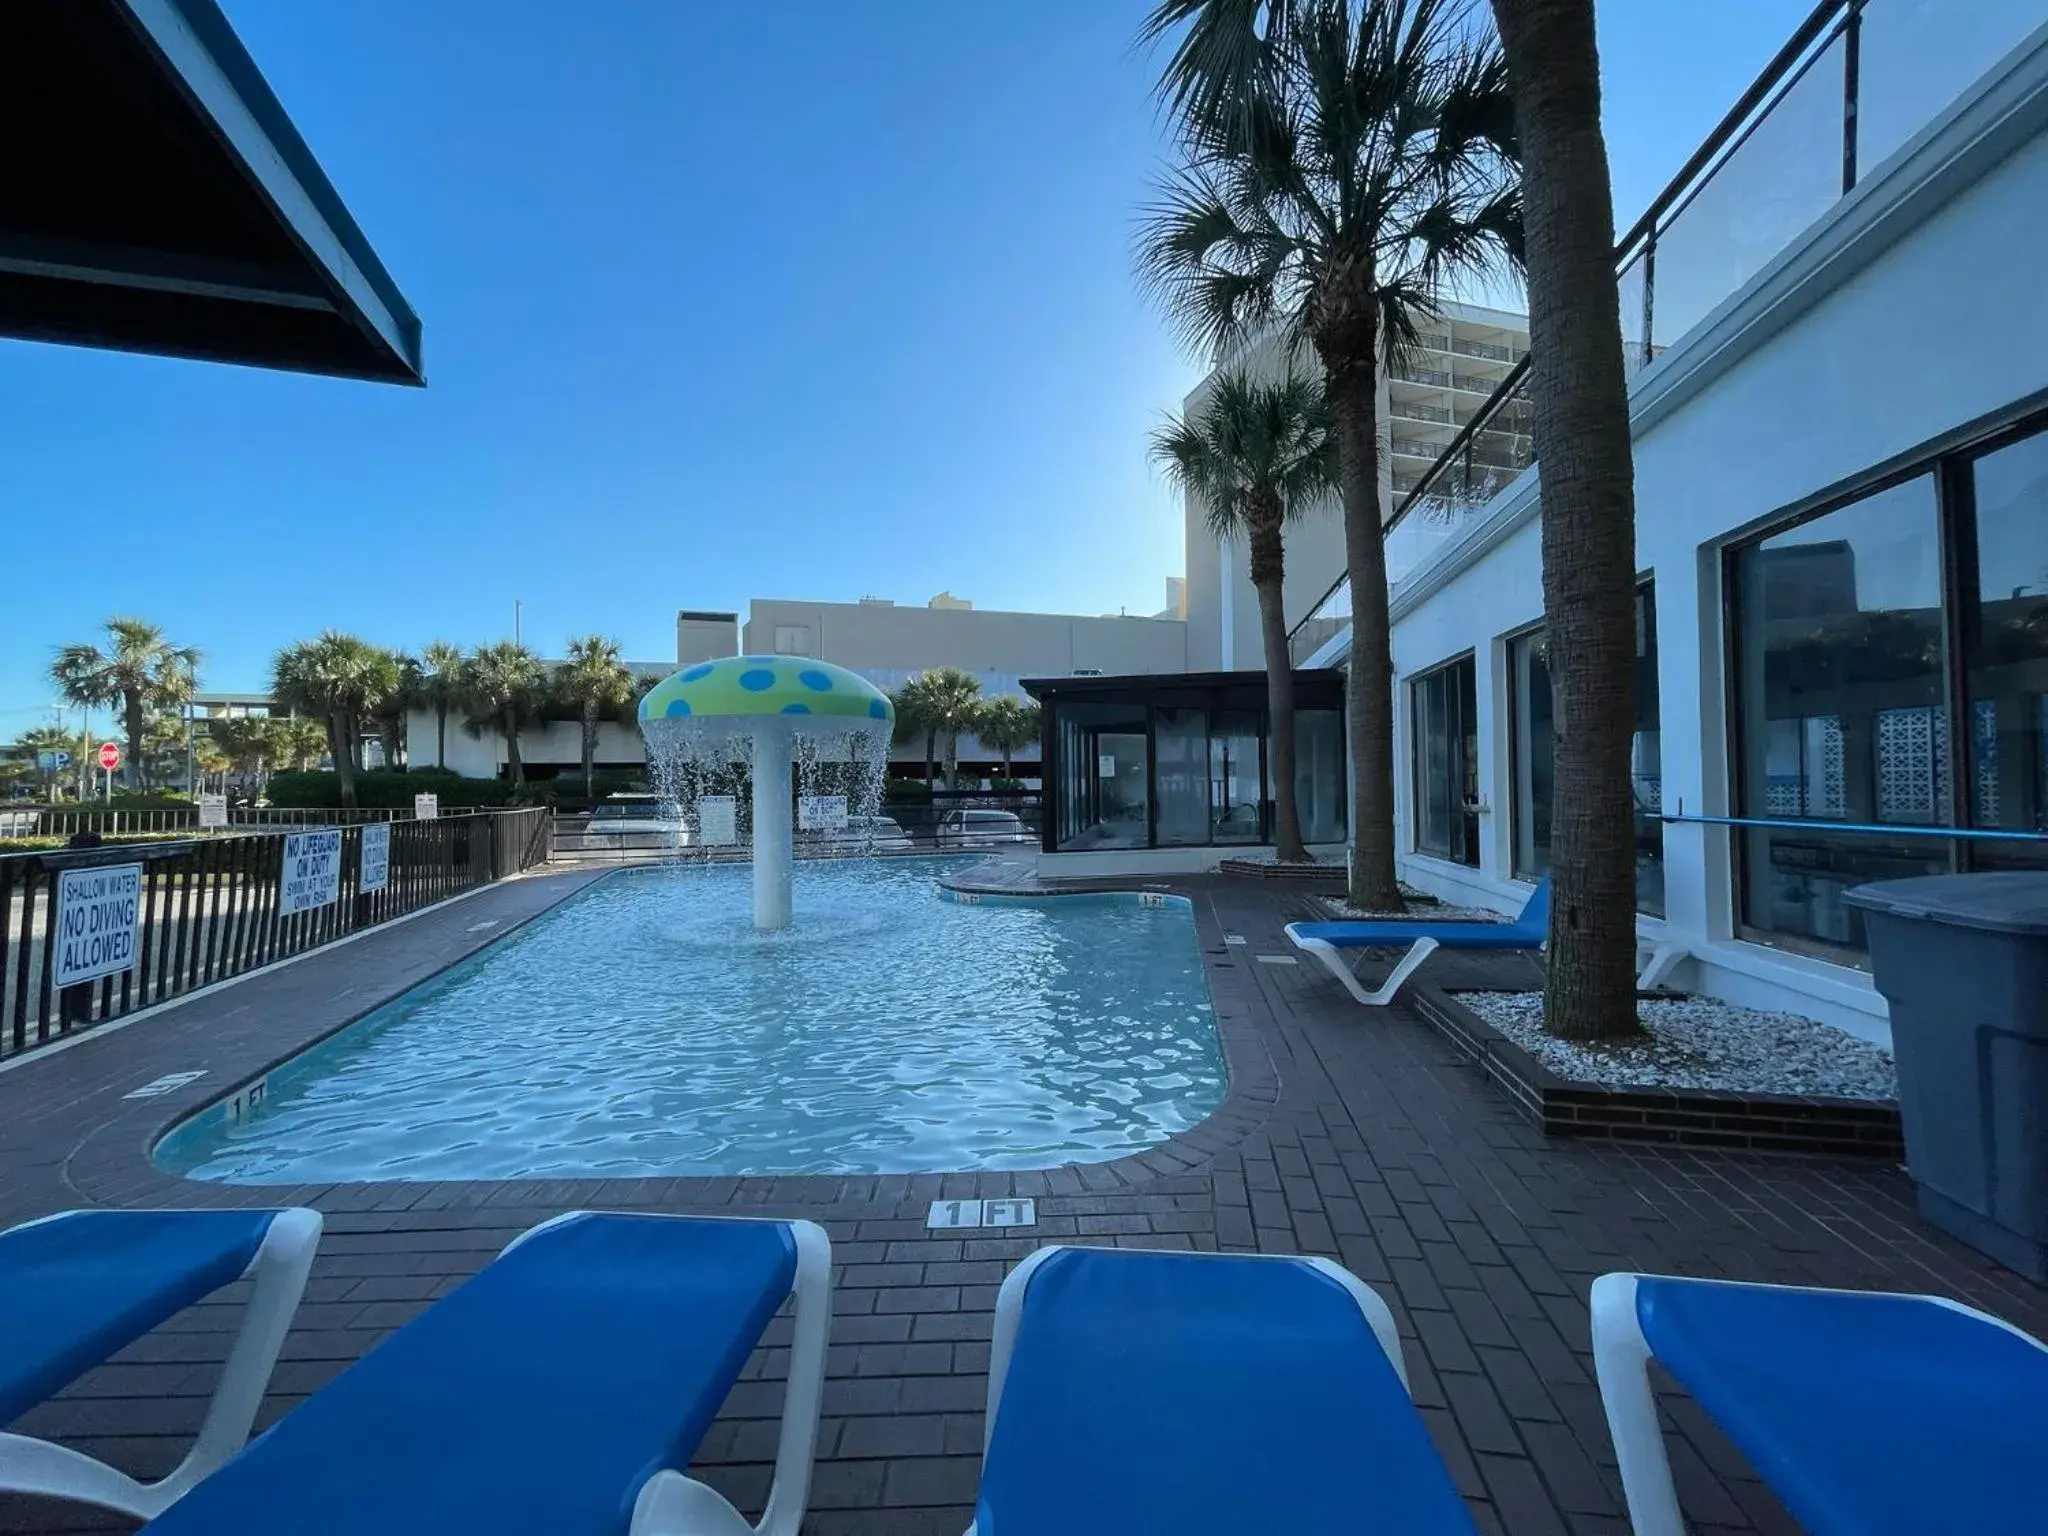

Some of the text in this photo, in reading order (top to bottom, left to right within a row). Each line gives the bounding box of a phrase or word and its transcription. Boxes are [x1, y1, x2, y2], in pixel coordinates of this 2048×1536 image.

[101, 750, 118, 760] STOP
[286, 832, 339, 858] NO LIFEGUARD
[297, 854, 329, 878] ON DUTY
[66, 874, 137, 902] SHALLOW WATER
[286, 880, 306, 896] SWIM
[307, 877, 317, 893] AT
[295, 894, 310, 910] OWN
[63, 899, 134, 939] NO DIVING
[62, 931, 131, 974] ALLOWED
[249, 1082, 266, 1107] FT
[946, 1200, 1031, 1226] 1 FT
